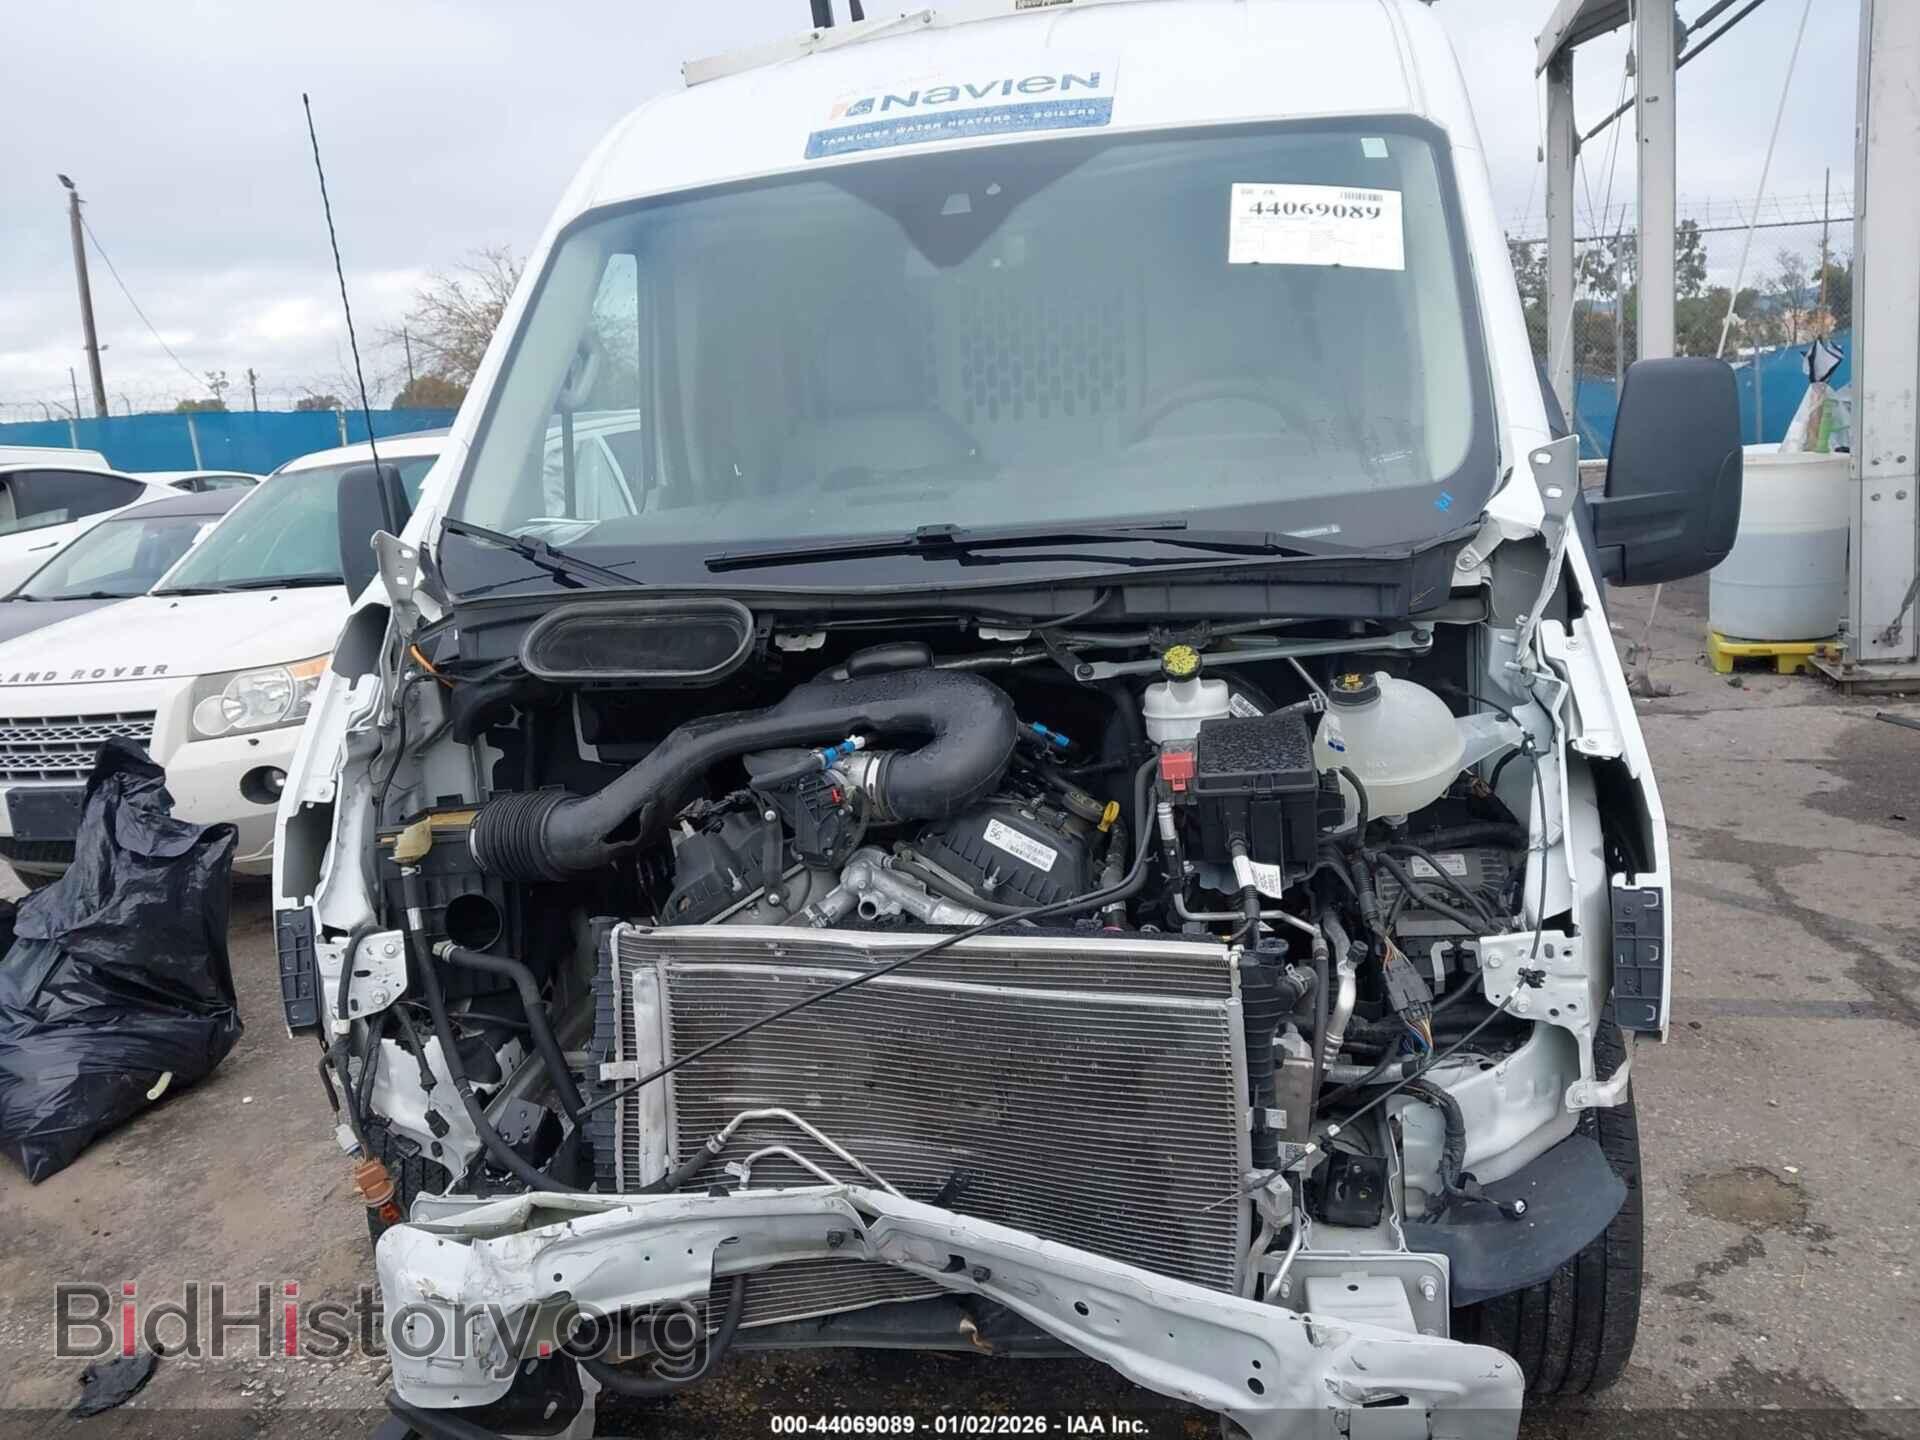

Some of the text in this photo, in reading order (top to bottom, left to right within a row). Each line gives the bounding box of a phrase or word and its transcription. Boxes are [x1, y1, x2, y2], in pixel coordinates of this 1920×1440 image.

[947, 114, 1011, 127] HEATERS
[1033, 108, 1096, 119] BOILERS
[1249, 201, 1381, 219] 44069089
[71, 664, 168, 680] ROVER
